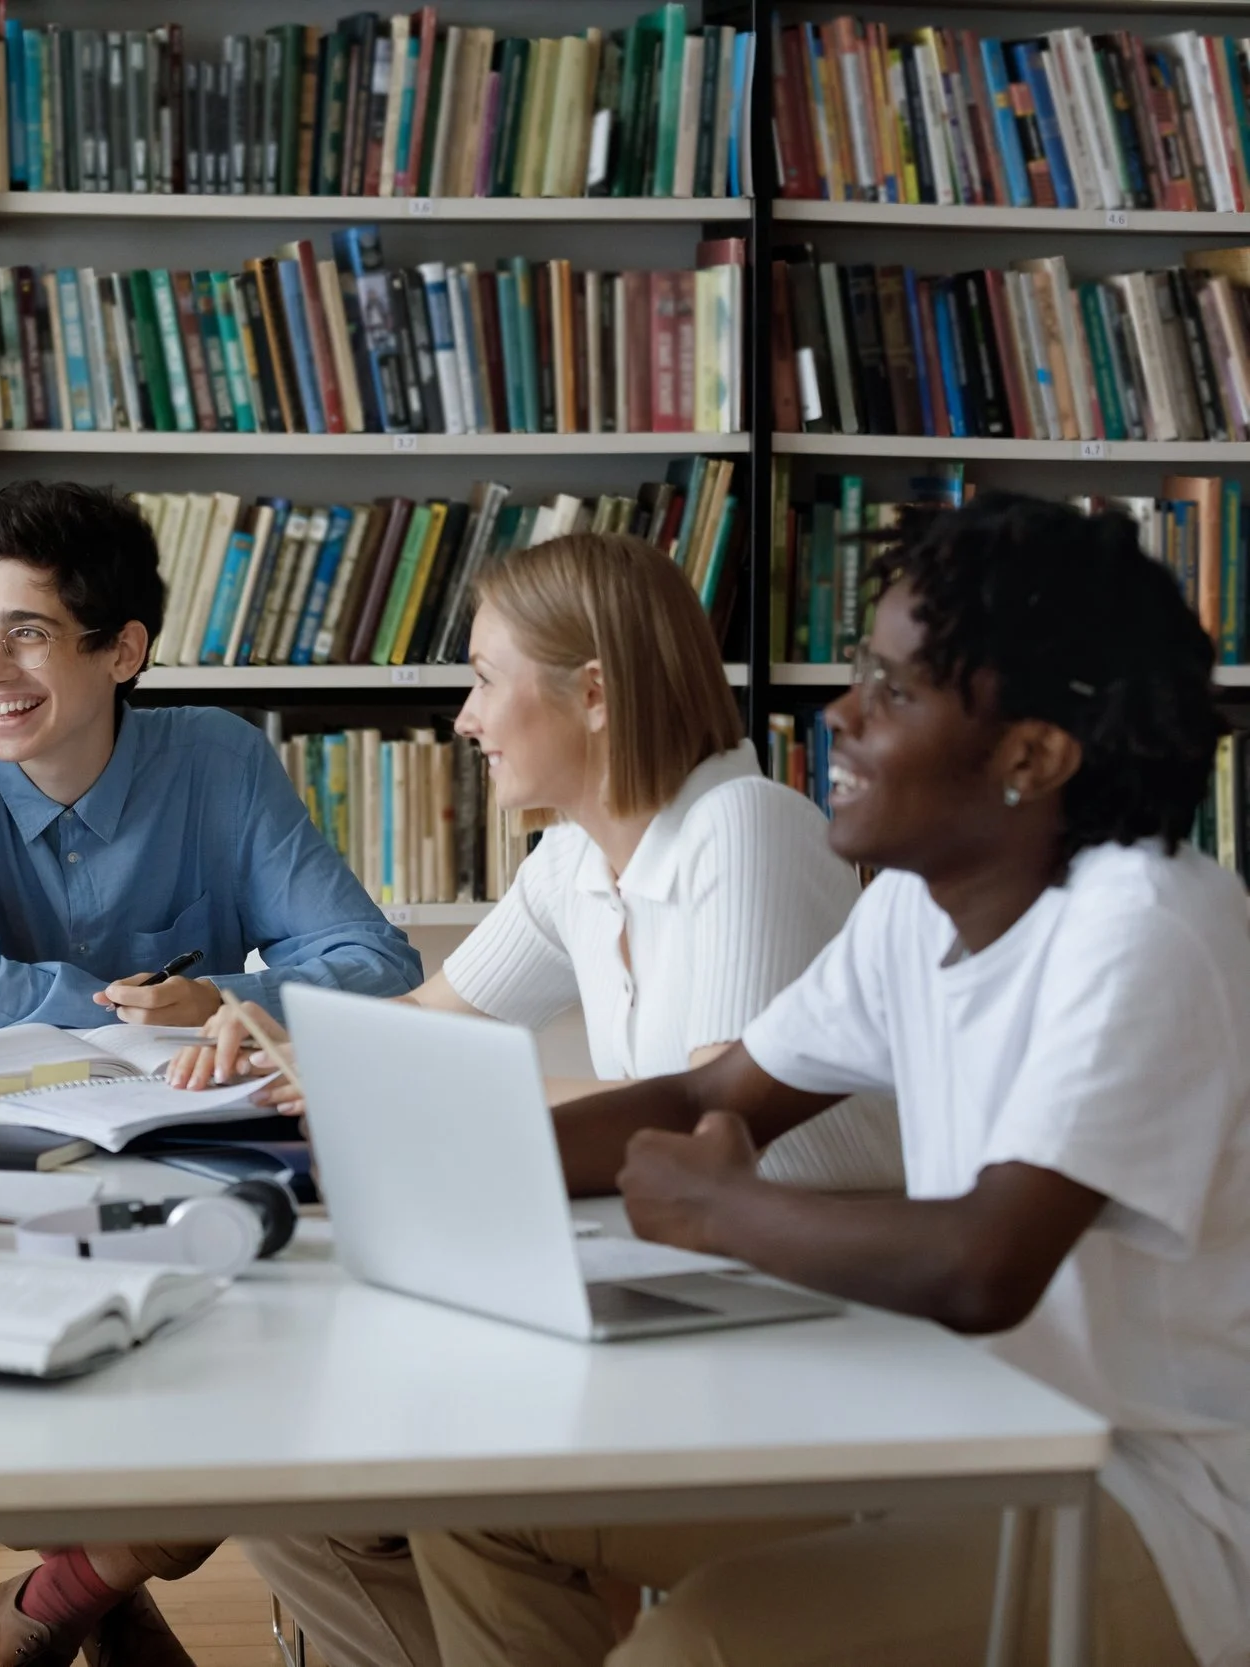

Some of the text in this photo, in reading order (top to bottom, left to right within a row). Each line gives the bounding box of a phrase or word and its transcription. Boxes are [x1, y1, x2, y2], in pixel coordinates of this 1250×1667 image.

[1108, 214, 1126, 225] 4.6
[397, 438, 414, 449] 3.7
[1084, 445, 1101, 456] 4.7
[397, 671, 414, 682] 3.8
